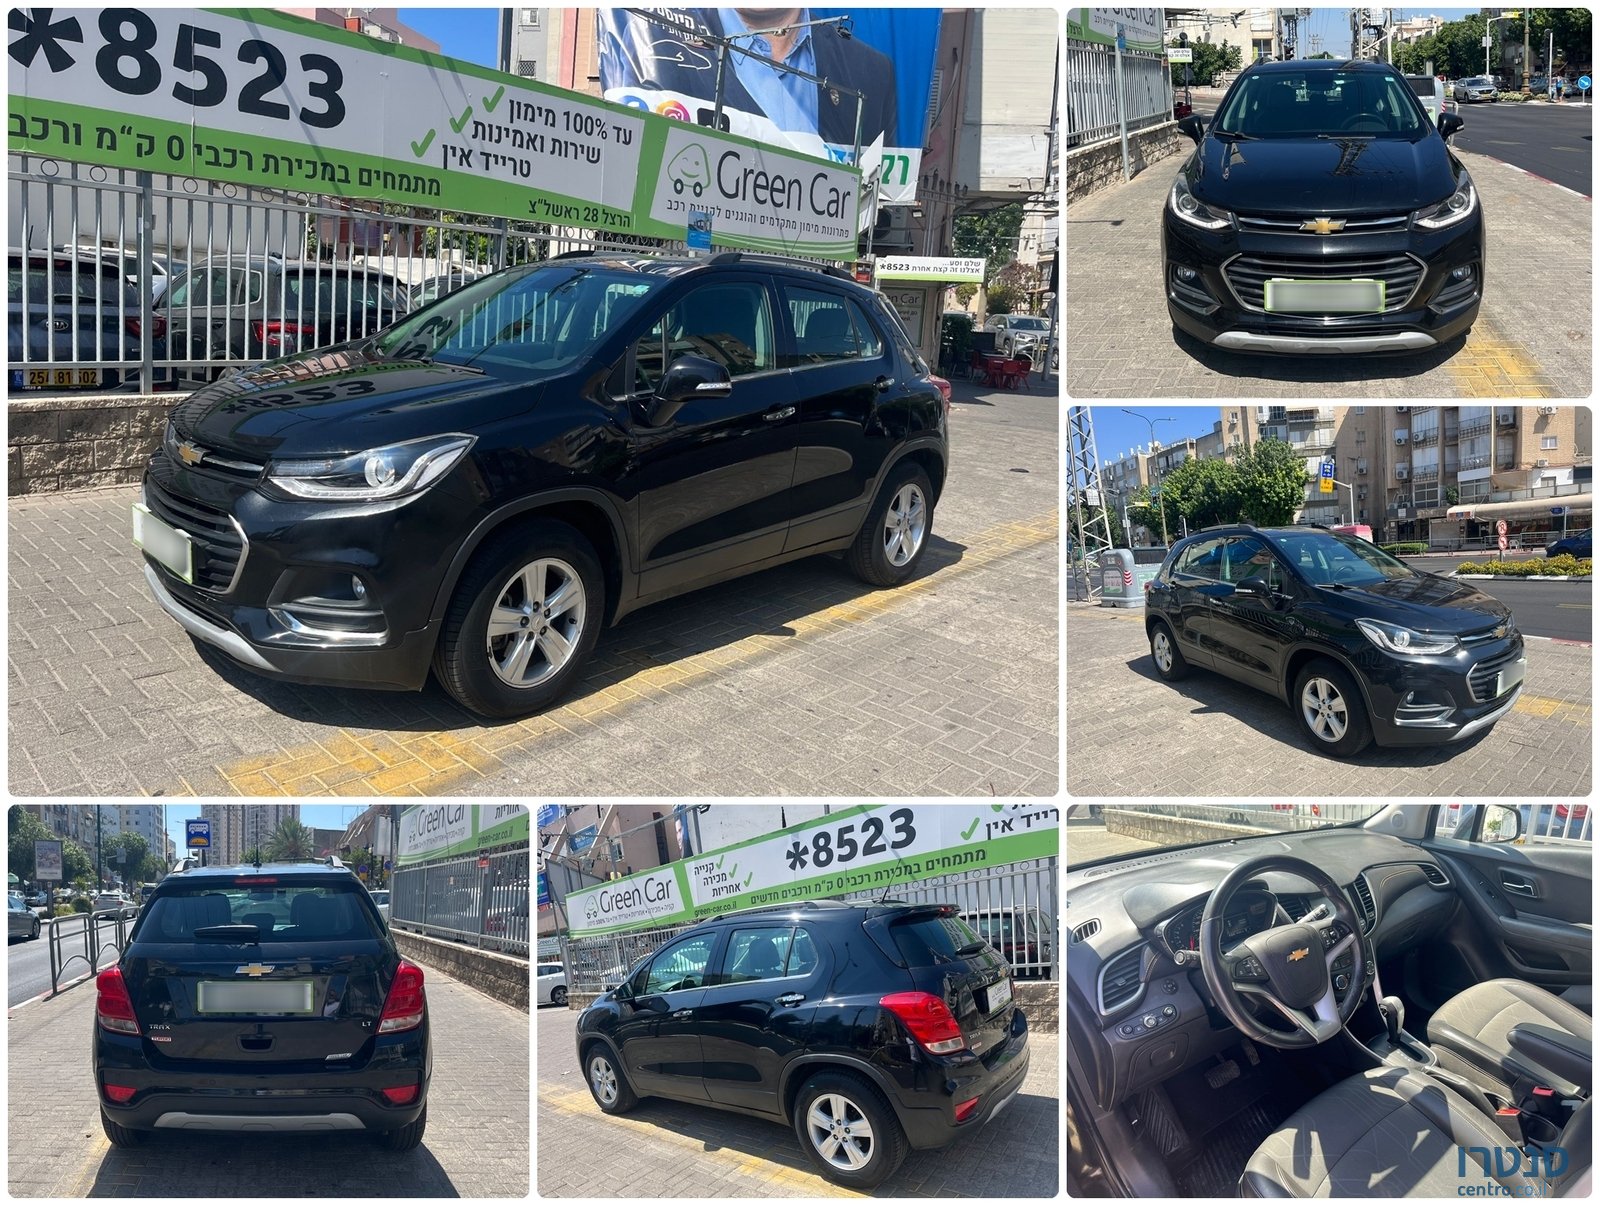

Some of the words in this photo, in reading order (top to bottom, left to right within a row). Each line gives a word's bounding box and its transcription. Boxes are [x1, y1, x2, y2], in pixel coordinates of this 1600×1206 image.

[509, 99, 556, 128] מימון
[563, 110, 608, 140] 100%
[612, 125, 632, 146] עד
[472, 119, 545, 153] ואמינות
[167, 135, 185, 161] 0
[193, 143, 253, 172] רכבי
[442, 144, 473, 170] אין
[550, 137, 601, 164] שירות
[261, 153, 350, 184] במכירת
[480, 151, 531, 178] טרייד
[358, 167, 440, 197] מתמחים
[717, 150, 801, 212] Green
[809, 172, 851, 220] Car
[583, 206, 599, 223] 28
[667, 199, 686, 212] רכב
[602, 208, 631, 228] הרצל
[760, 214, 797, 230] מתקדמים
[799, 220, 819, 234] מימון
[820, 225, 850, 239] פתרונות
[901, 293, 920, 304] Car
[417, 805, 445, 837] Green
[986, 817, 1014, 841] אין
[477, 826, 513, 847] green-car.co.il
[694, 862, 714, 875] קנייה
[926, 848, 986, 872] מתמחים
[703, 872, 727, 886] מכירה
[847, 872, 871, 887] רכבי
[874, 861, 922, 882] במכירת
[712, 882, 741, 897] אחריות
[782, 885, 811, 899] ורכבים
[836, 877, 844, 889] 0
[599, 887, 642, 913] Green
[644, 877, 672, 903] Car
[750, 892, 779, 905] חדשים
[694, 901, 737, 917] green-car.co.il
